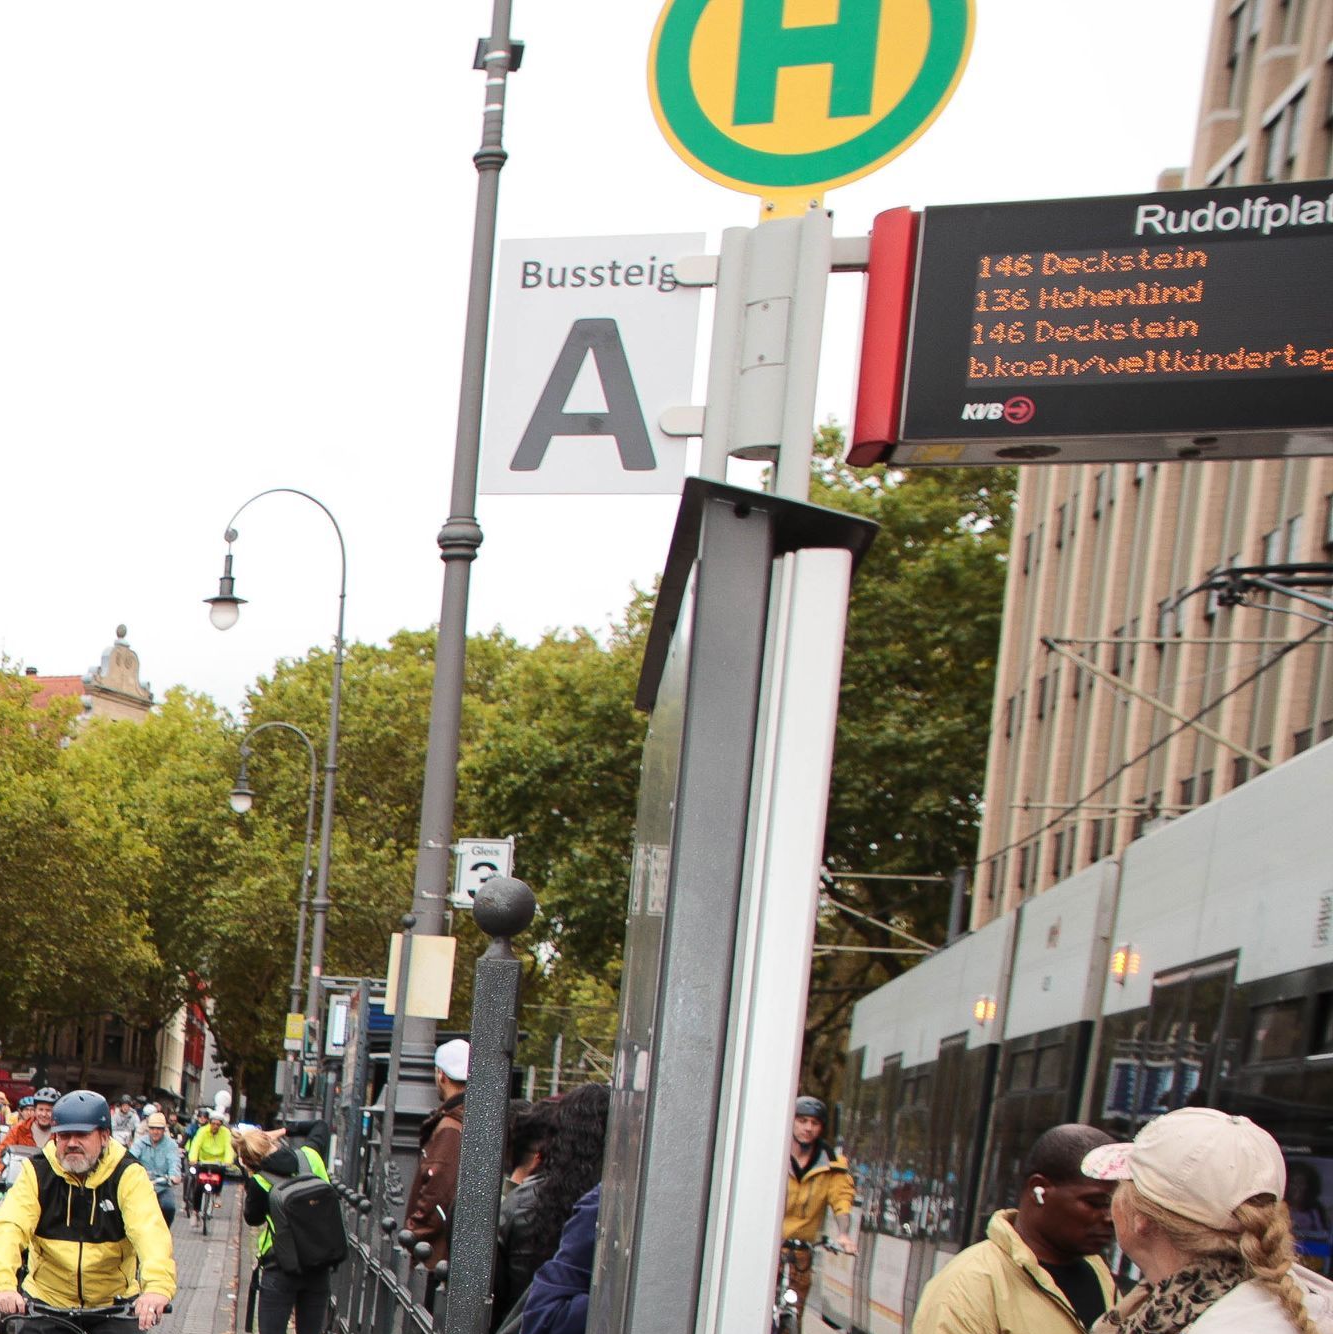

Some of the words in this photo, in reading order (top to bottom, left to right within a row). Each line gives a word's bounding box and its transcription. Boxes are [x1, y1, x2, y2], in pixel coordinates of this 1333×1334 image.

[733, 0, 882, 127] H
[520, 257, 679, 291] Bussteig
[978, 254, 1033, 279] 146
[1041, 246, 1209, 276] Deckstein
[974, 287, 1030, 313] 136
[1037, 280, 1204, 310] Hohenlind
[971, 320, 1026, 345] 146
[1034, 315, 1200, 343] Deckstein
[509, 318, 657, 471] A
[961, 401, 1004, 420] KVB
[471, 845, 501, 857] Gleis
